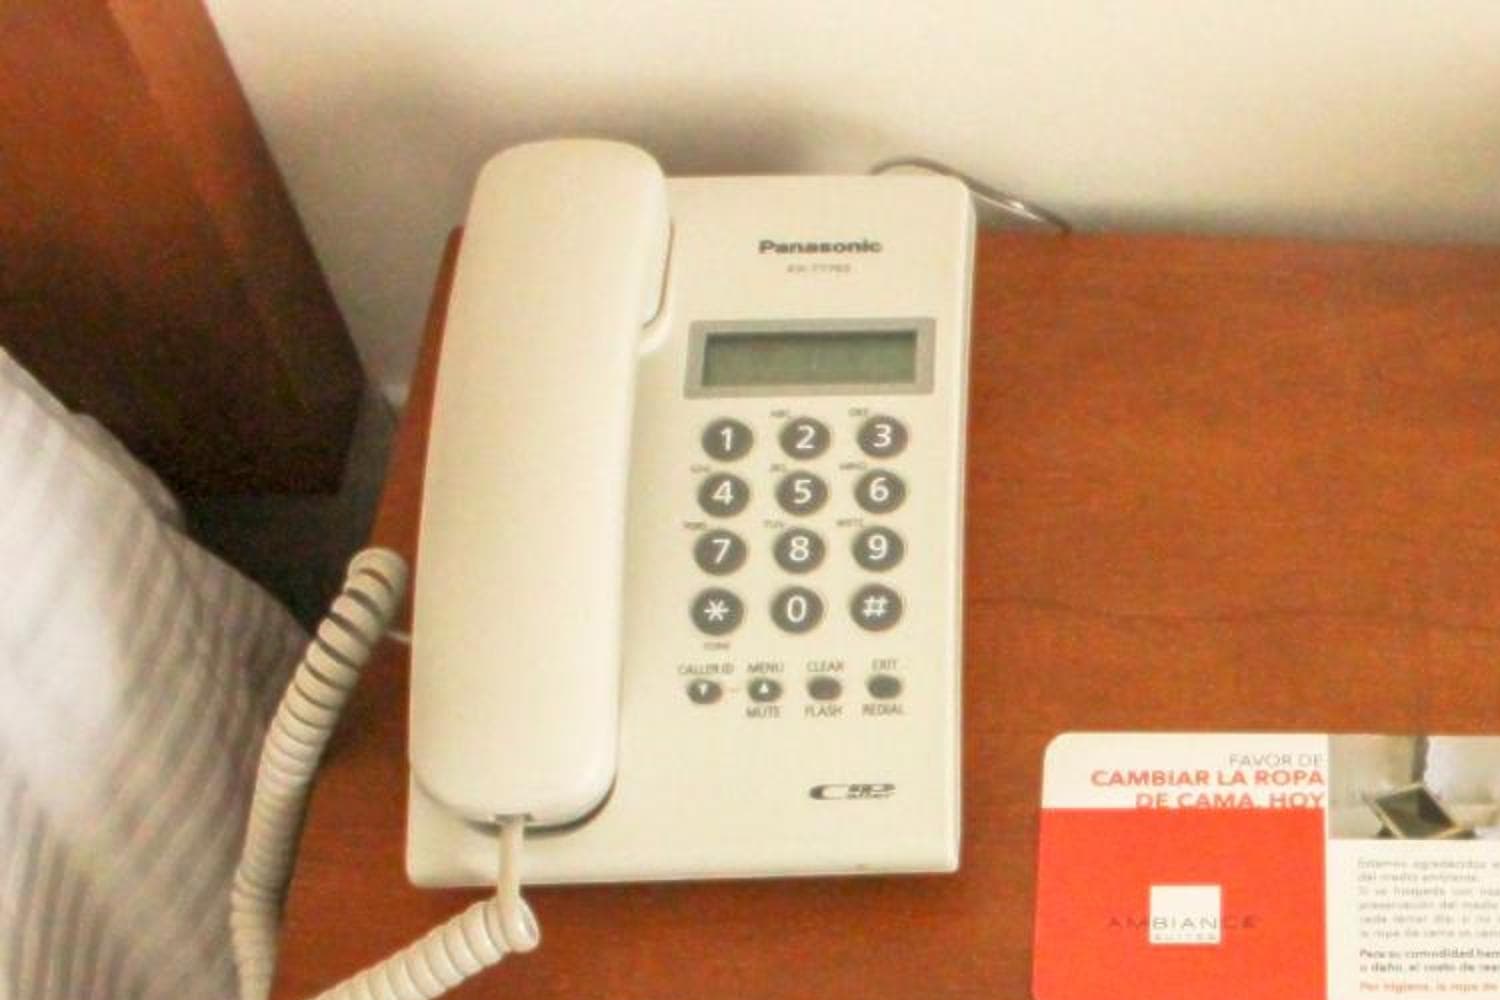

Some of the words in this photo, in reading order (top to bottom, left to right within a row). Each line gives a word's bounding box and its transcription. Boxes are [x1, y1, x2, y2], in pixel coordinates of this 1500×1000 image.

[758, 238, 883, 253] Panasonic
[721, 427, 733, 451] 1
[796, 425, 816, 449] 2
[873, 424, 892, 447] 3
[711, 480, 733, 505] 4
[793, 479, 812, 504] 5
[869, 477, 889, 501] 6
[712, 539, 731, 563] 7
[789, 536, 810, 561] 8
[867, 535, 888, 560] 9
[787, 596, 807, 622] 0
[862, 596, 888, 617] #
[678, 664, 718, 674] CALLER
[722, 663, 734, 673] ID
[747, 662, 784, 673] MENU
[806, 660, 844, 672] CLEAR
[872, 659, 898, 670] EXIT
[747, 706, 780, 718] MUTE
[804, 705, 843, 717] FLASH
[862, 703, 904, 716] REDIAL
[1230, 754, 1293, 767] FAVOR
[1299, 754, 1324, 767] DE
[1091, 769, 1209, 786] CAMBIAR
[1217, 769, 1247, 786] LA
[1254, 769, 1325, 786] ROPA
[1136, 792, 1169, 809] DE
[1269, 792, 1326, 809] HOY
[1107, 916, 1258, 930] AMBIANCE
